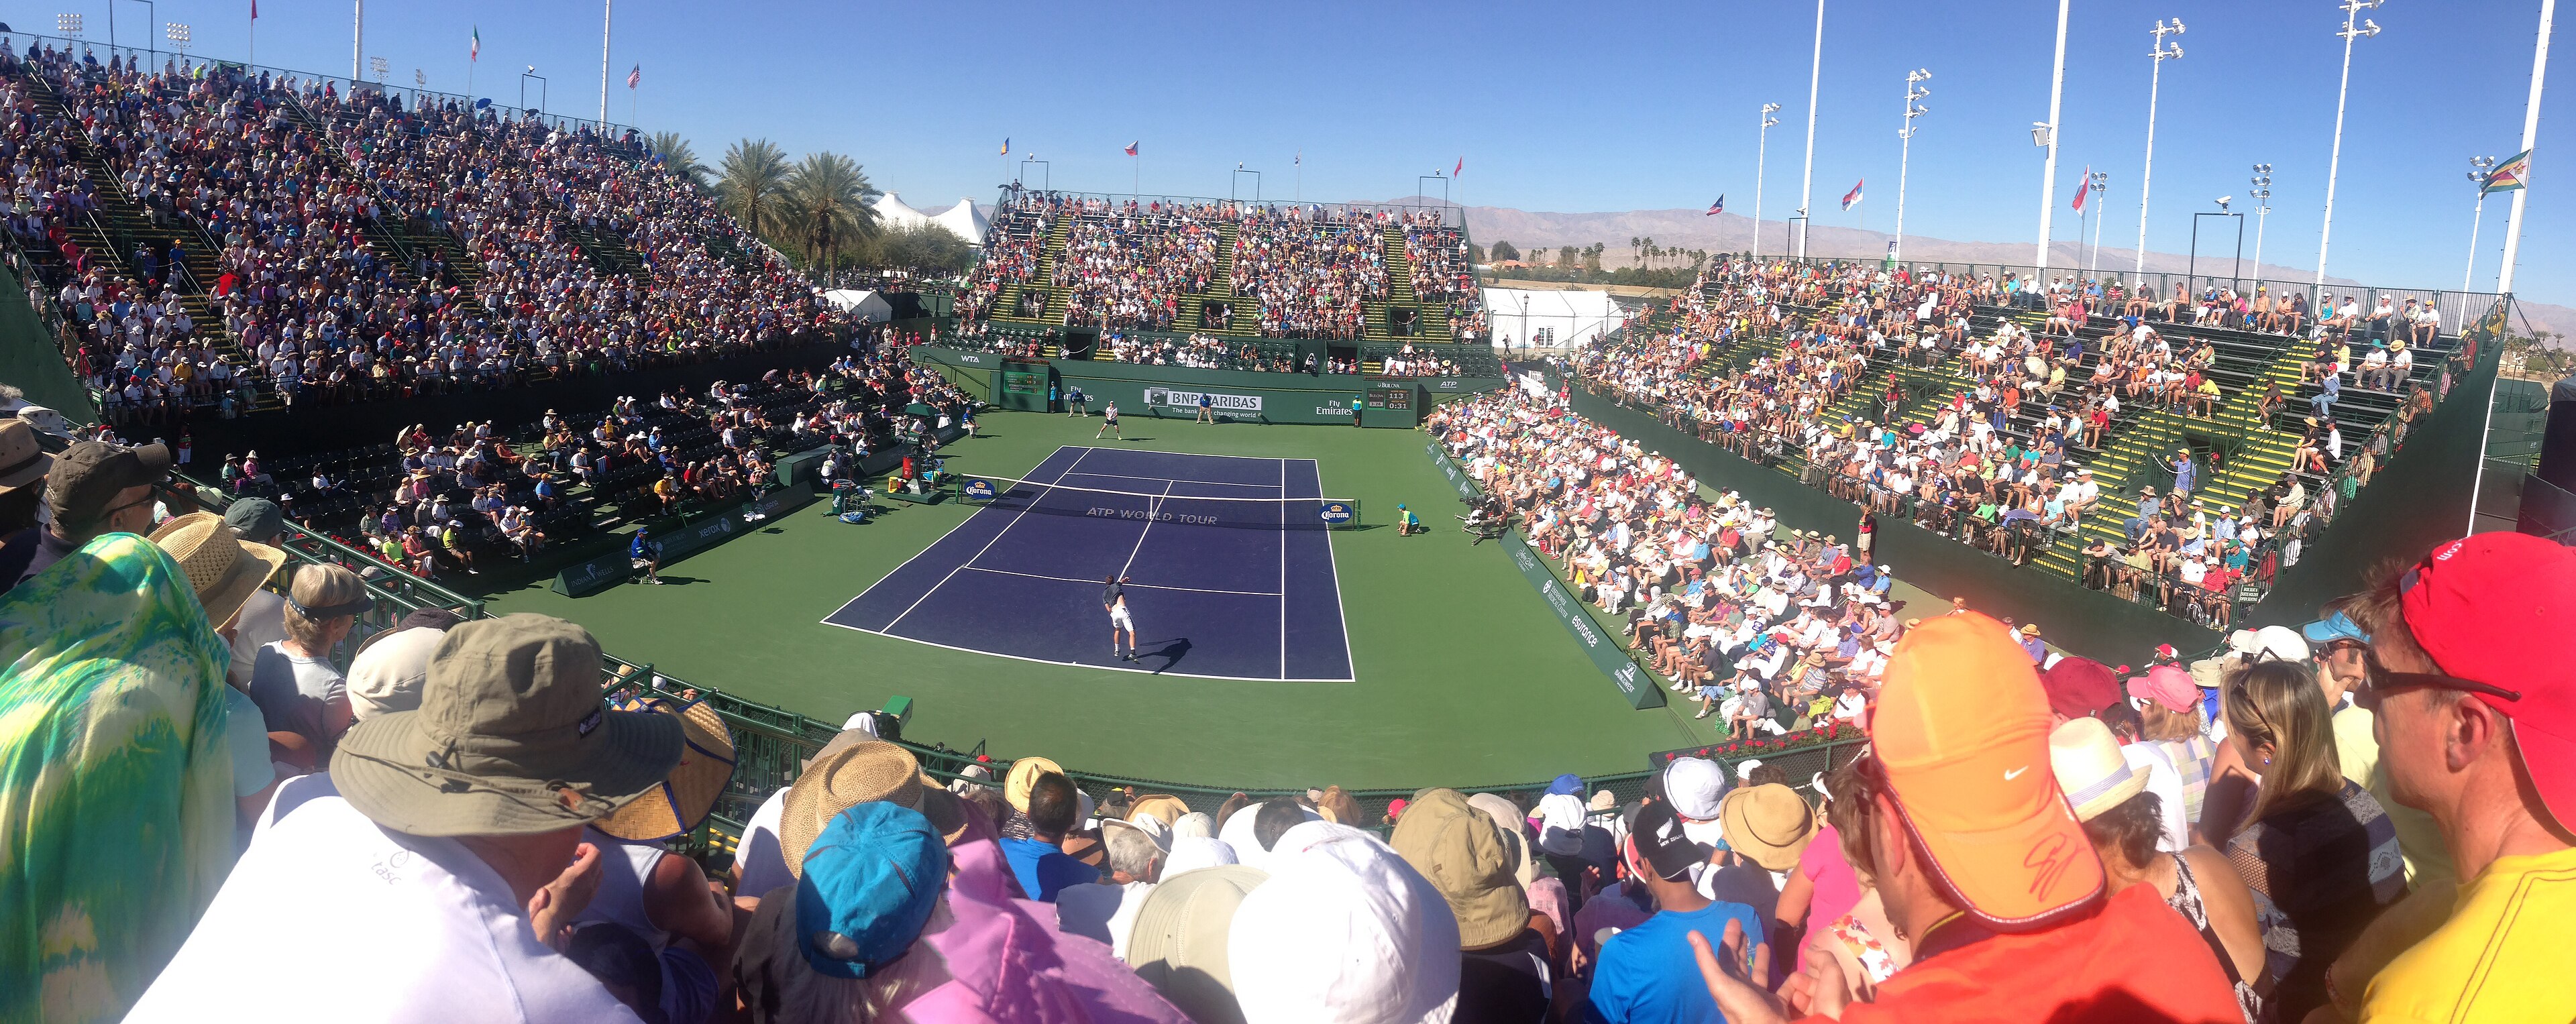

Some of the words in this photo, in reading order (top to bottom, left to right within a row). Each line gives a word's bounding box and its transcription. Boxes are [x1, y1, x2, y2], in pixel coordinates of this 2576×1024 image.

[961, 355, 979, 363] WTA
[1173, 393, 1198, 404] BNP
[1329, 400, 1340, 408] Fly
[1214, 410, 1238, 418] changing
[1316, 406, 1352, 416] Emirates
[966, 486, 992, 496] Corona
[1086, 507, 1114, 517] ATP
[1179, 514, 1218, 525] TOUR
[1321, 510, 1350, 520] Corona
[698, 524, 720, 538] xerox
[571, 575, 592, 587] INDIAN
[596, 566, 614, 577] WELLS
[1572, 615, 1597, 648] esurance
[371, 861, 402, 885] tasc
